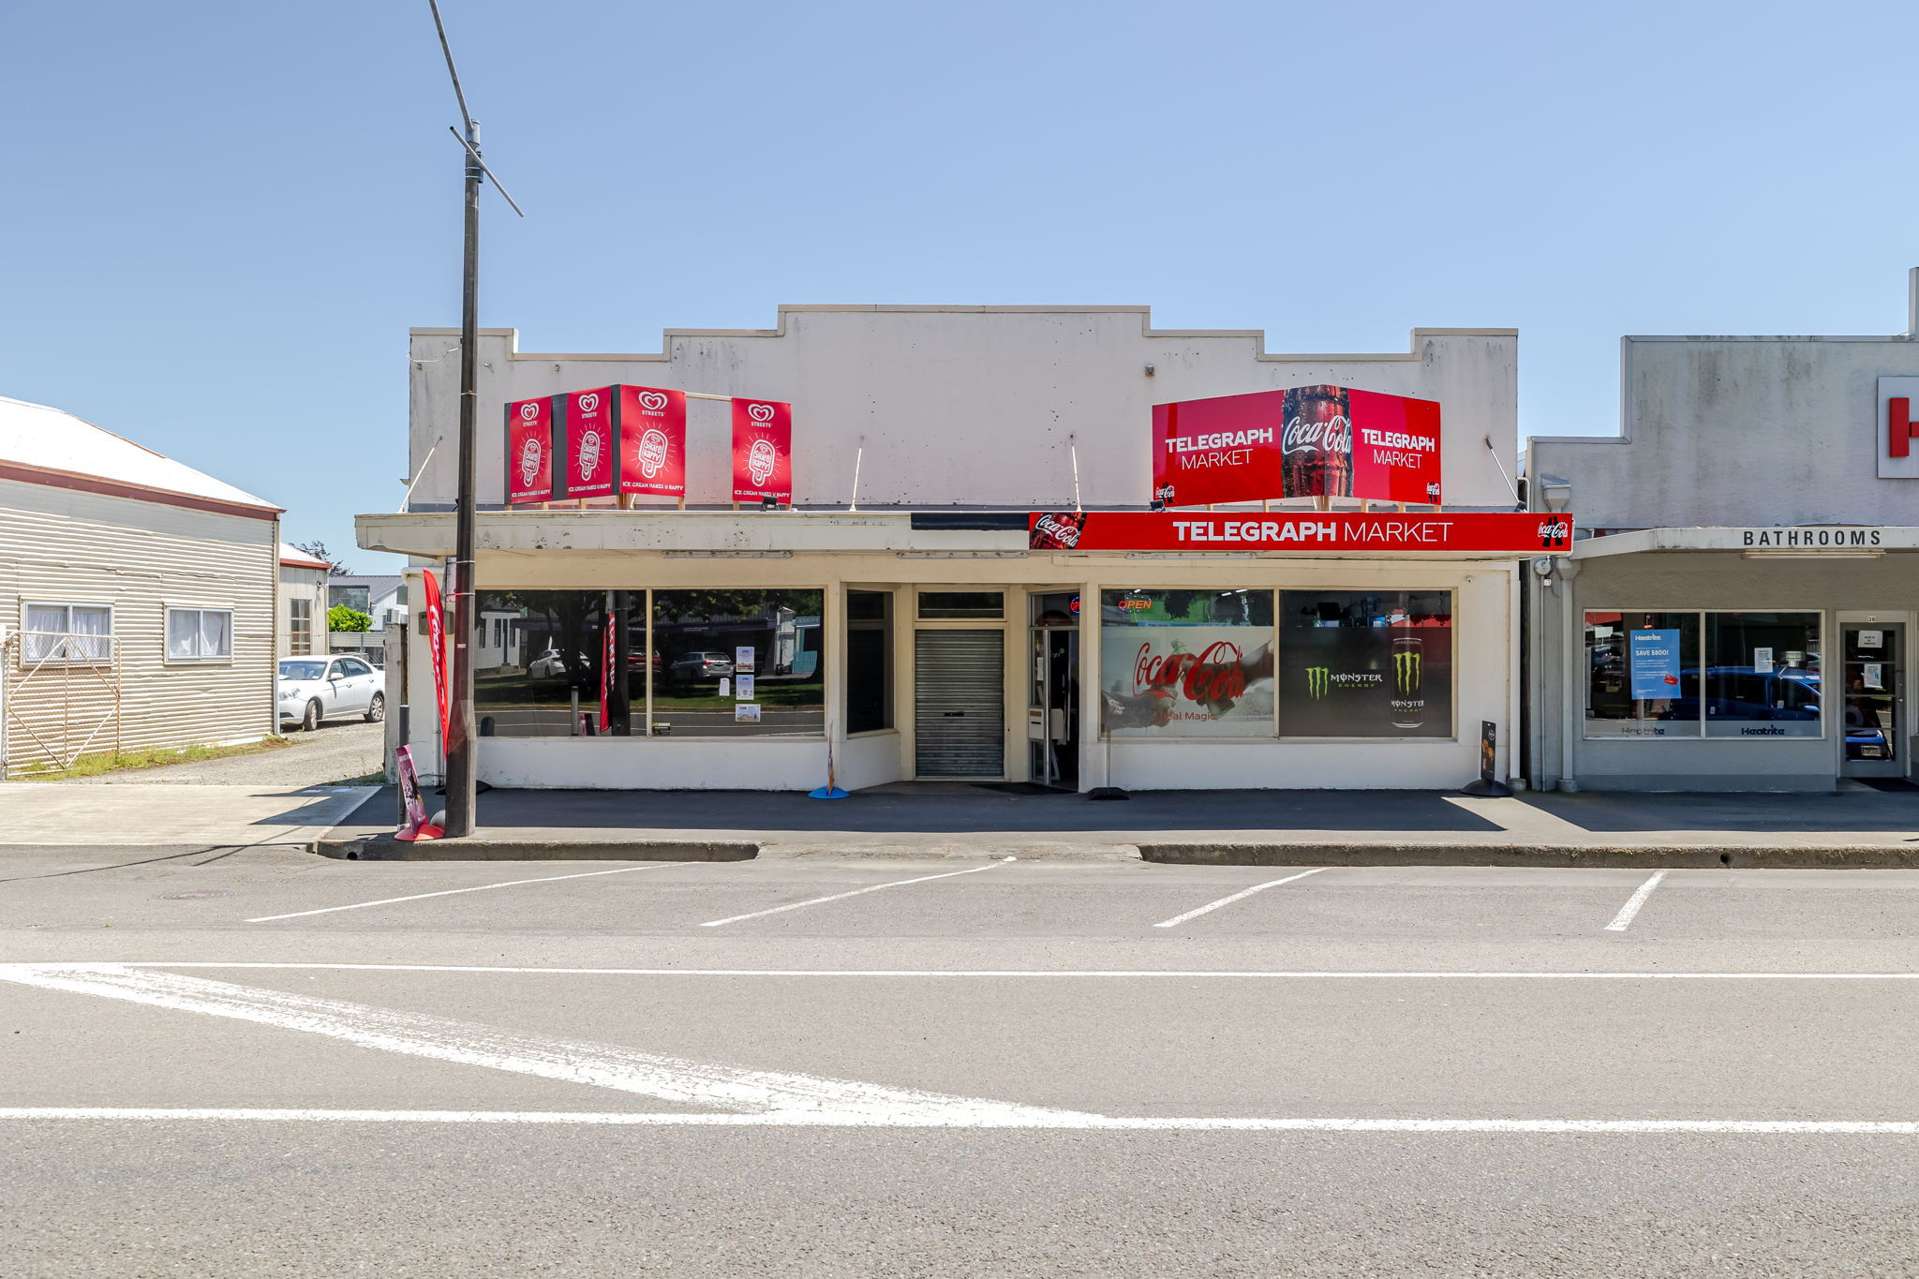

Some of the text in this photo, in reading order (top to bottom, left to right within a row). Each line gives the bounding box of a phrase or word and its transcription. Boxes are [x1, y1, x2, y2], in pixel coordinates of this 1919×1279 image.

[1165, 427, 1273, 453] TELEGRAPH
[1361, 428, 1435, 453] TELEGRAPH
[1181, 448, 1254, 470] MARKET
[1373, 449, 1422, 469] MARKET
[1173, 521, 1453, 541] TELEGRAPH MARKET
[1743, 530, 1881, 545] BATHROOMS
[1119, 599, 1152, 609] OPEN
[1330, 673, 1383, 682] MONSTER
[1741, 724, 1785, 736] Heatrite
